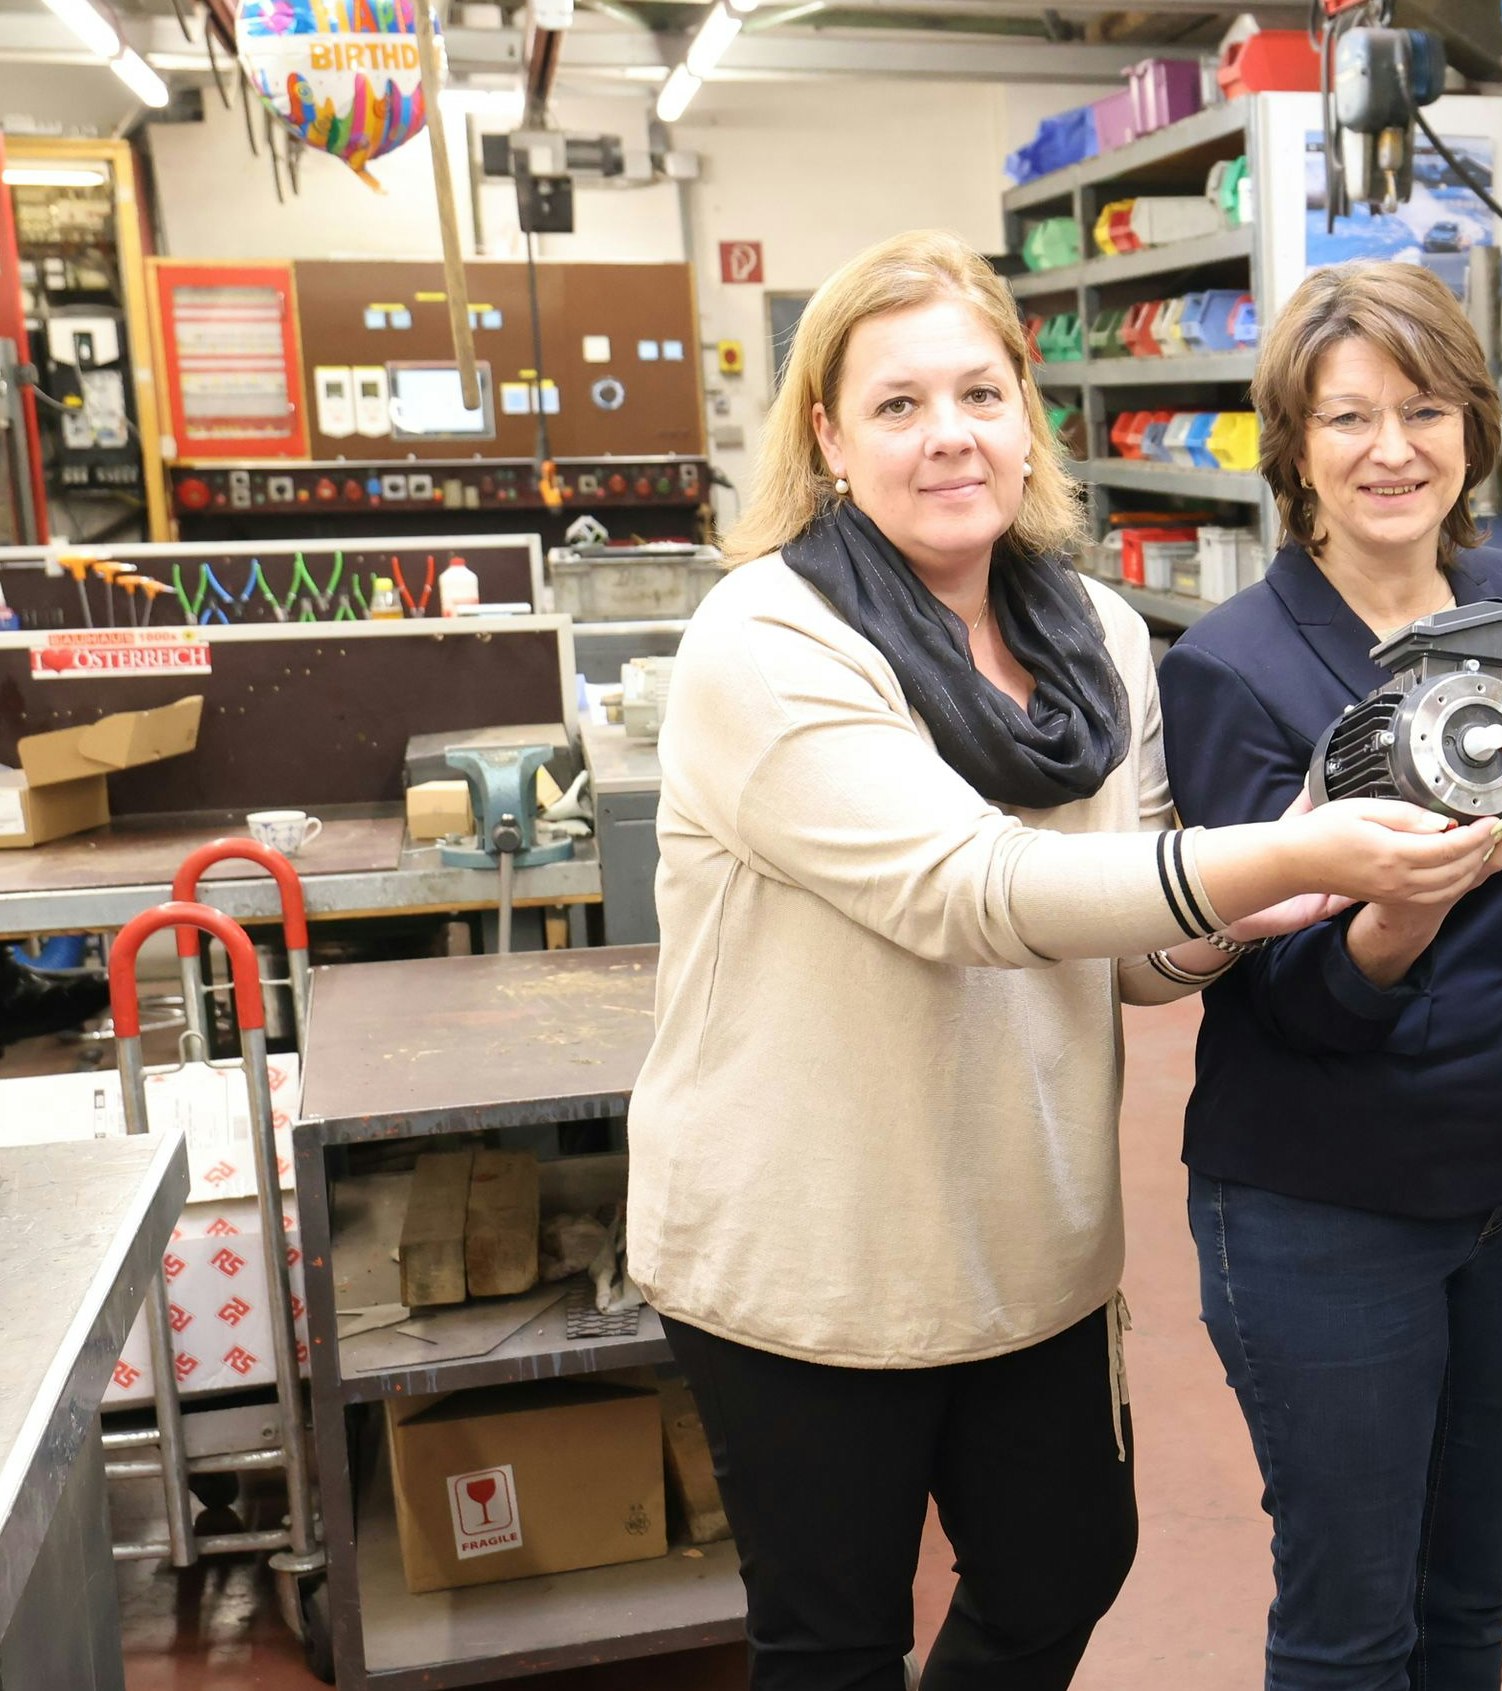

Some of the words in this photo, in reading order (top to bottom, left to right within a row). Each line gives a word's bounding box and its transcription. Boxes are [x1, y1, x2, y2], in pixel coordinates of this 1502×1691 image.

[310, 0, 416, 33] HAPP
[309, 43, 420, 71] BIRTHD
[74, 647, 207, 668] ÖSTERREICH
[210, 1248, 247, 1278] RS
[216, 1297, 252, 1328] RS
[222, 1345, 258, 1377] RS
[461, 1532, 518, 1552] FRAGILE
